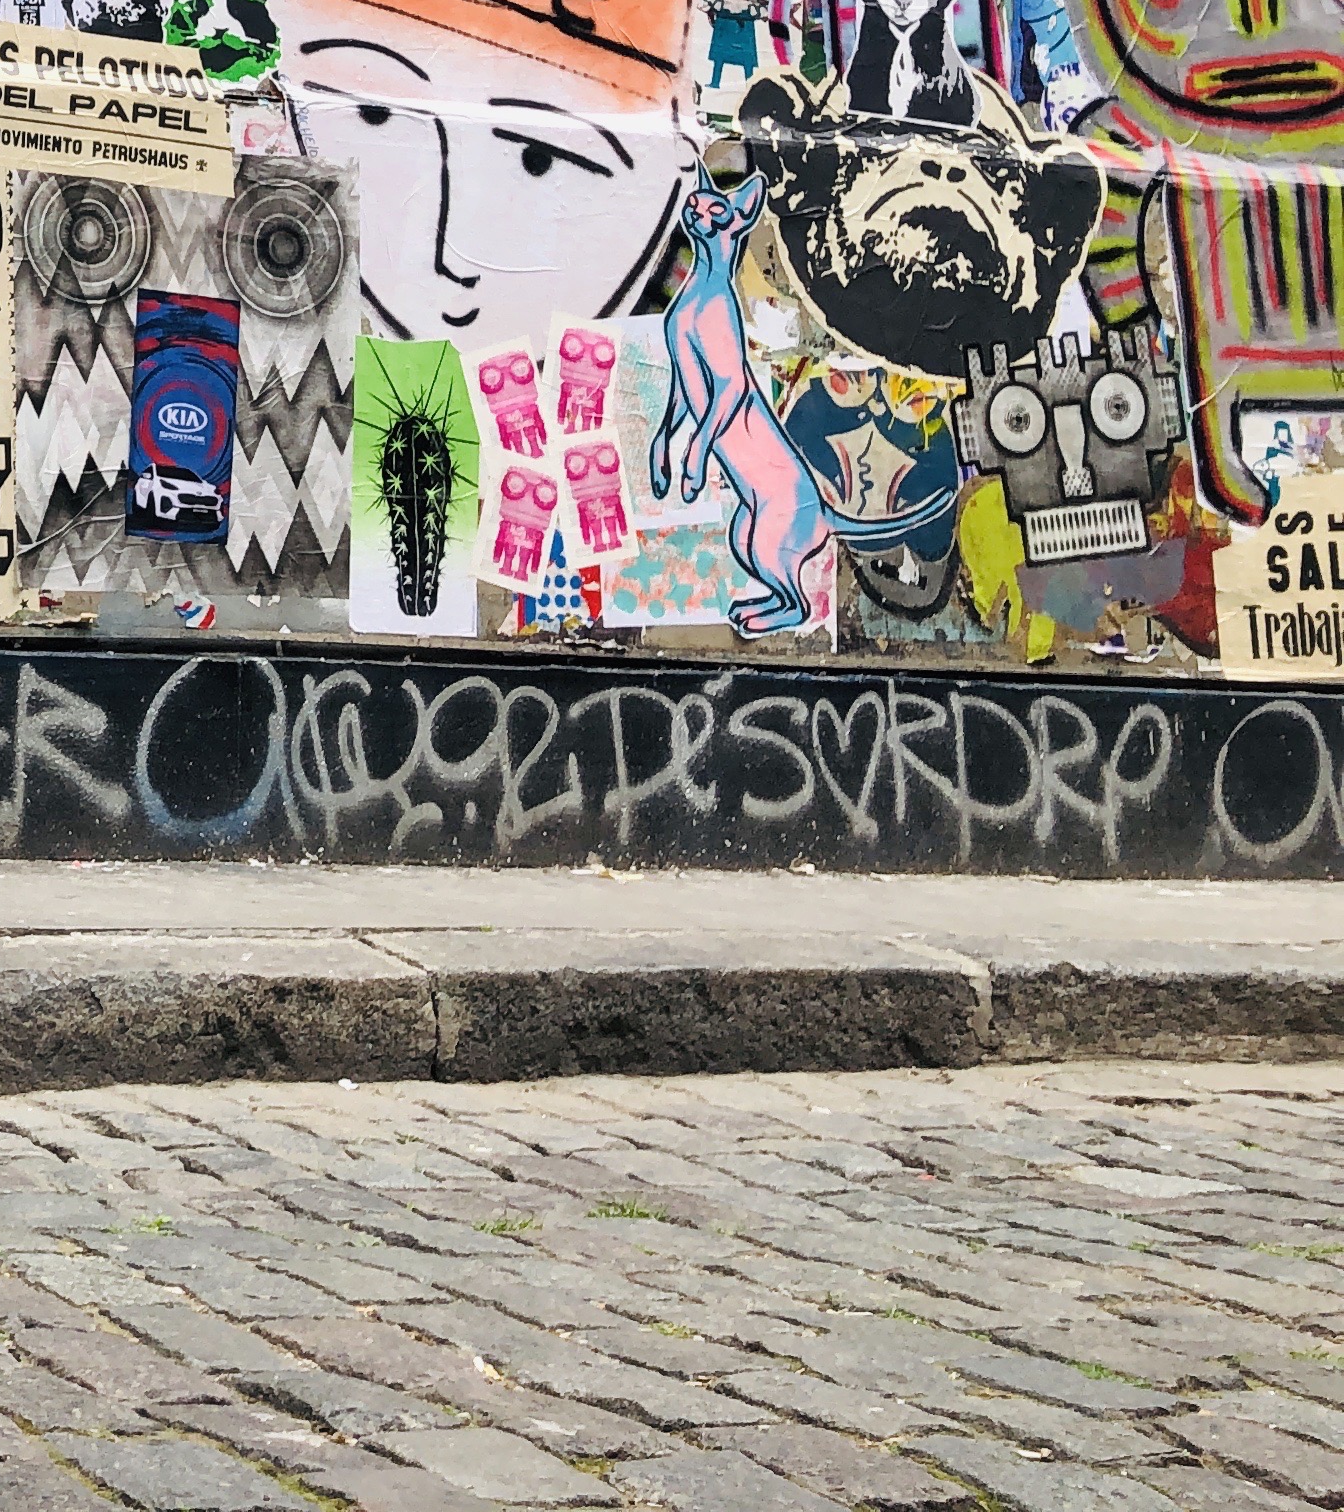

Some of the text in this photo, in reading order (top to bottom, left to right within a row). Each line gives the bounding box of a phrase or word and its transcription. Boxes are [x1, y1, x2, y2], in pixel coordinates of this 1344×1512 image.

[68, 93, 208, 134] PAPEL
[92, 138, 189, 172] PETRUSHAUS
[166, 407, 200, 427] KIA
[1242, 601, 1344, 668] Trabaj
